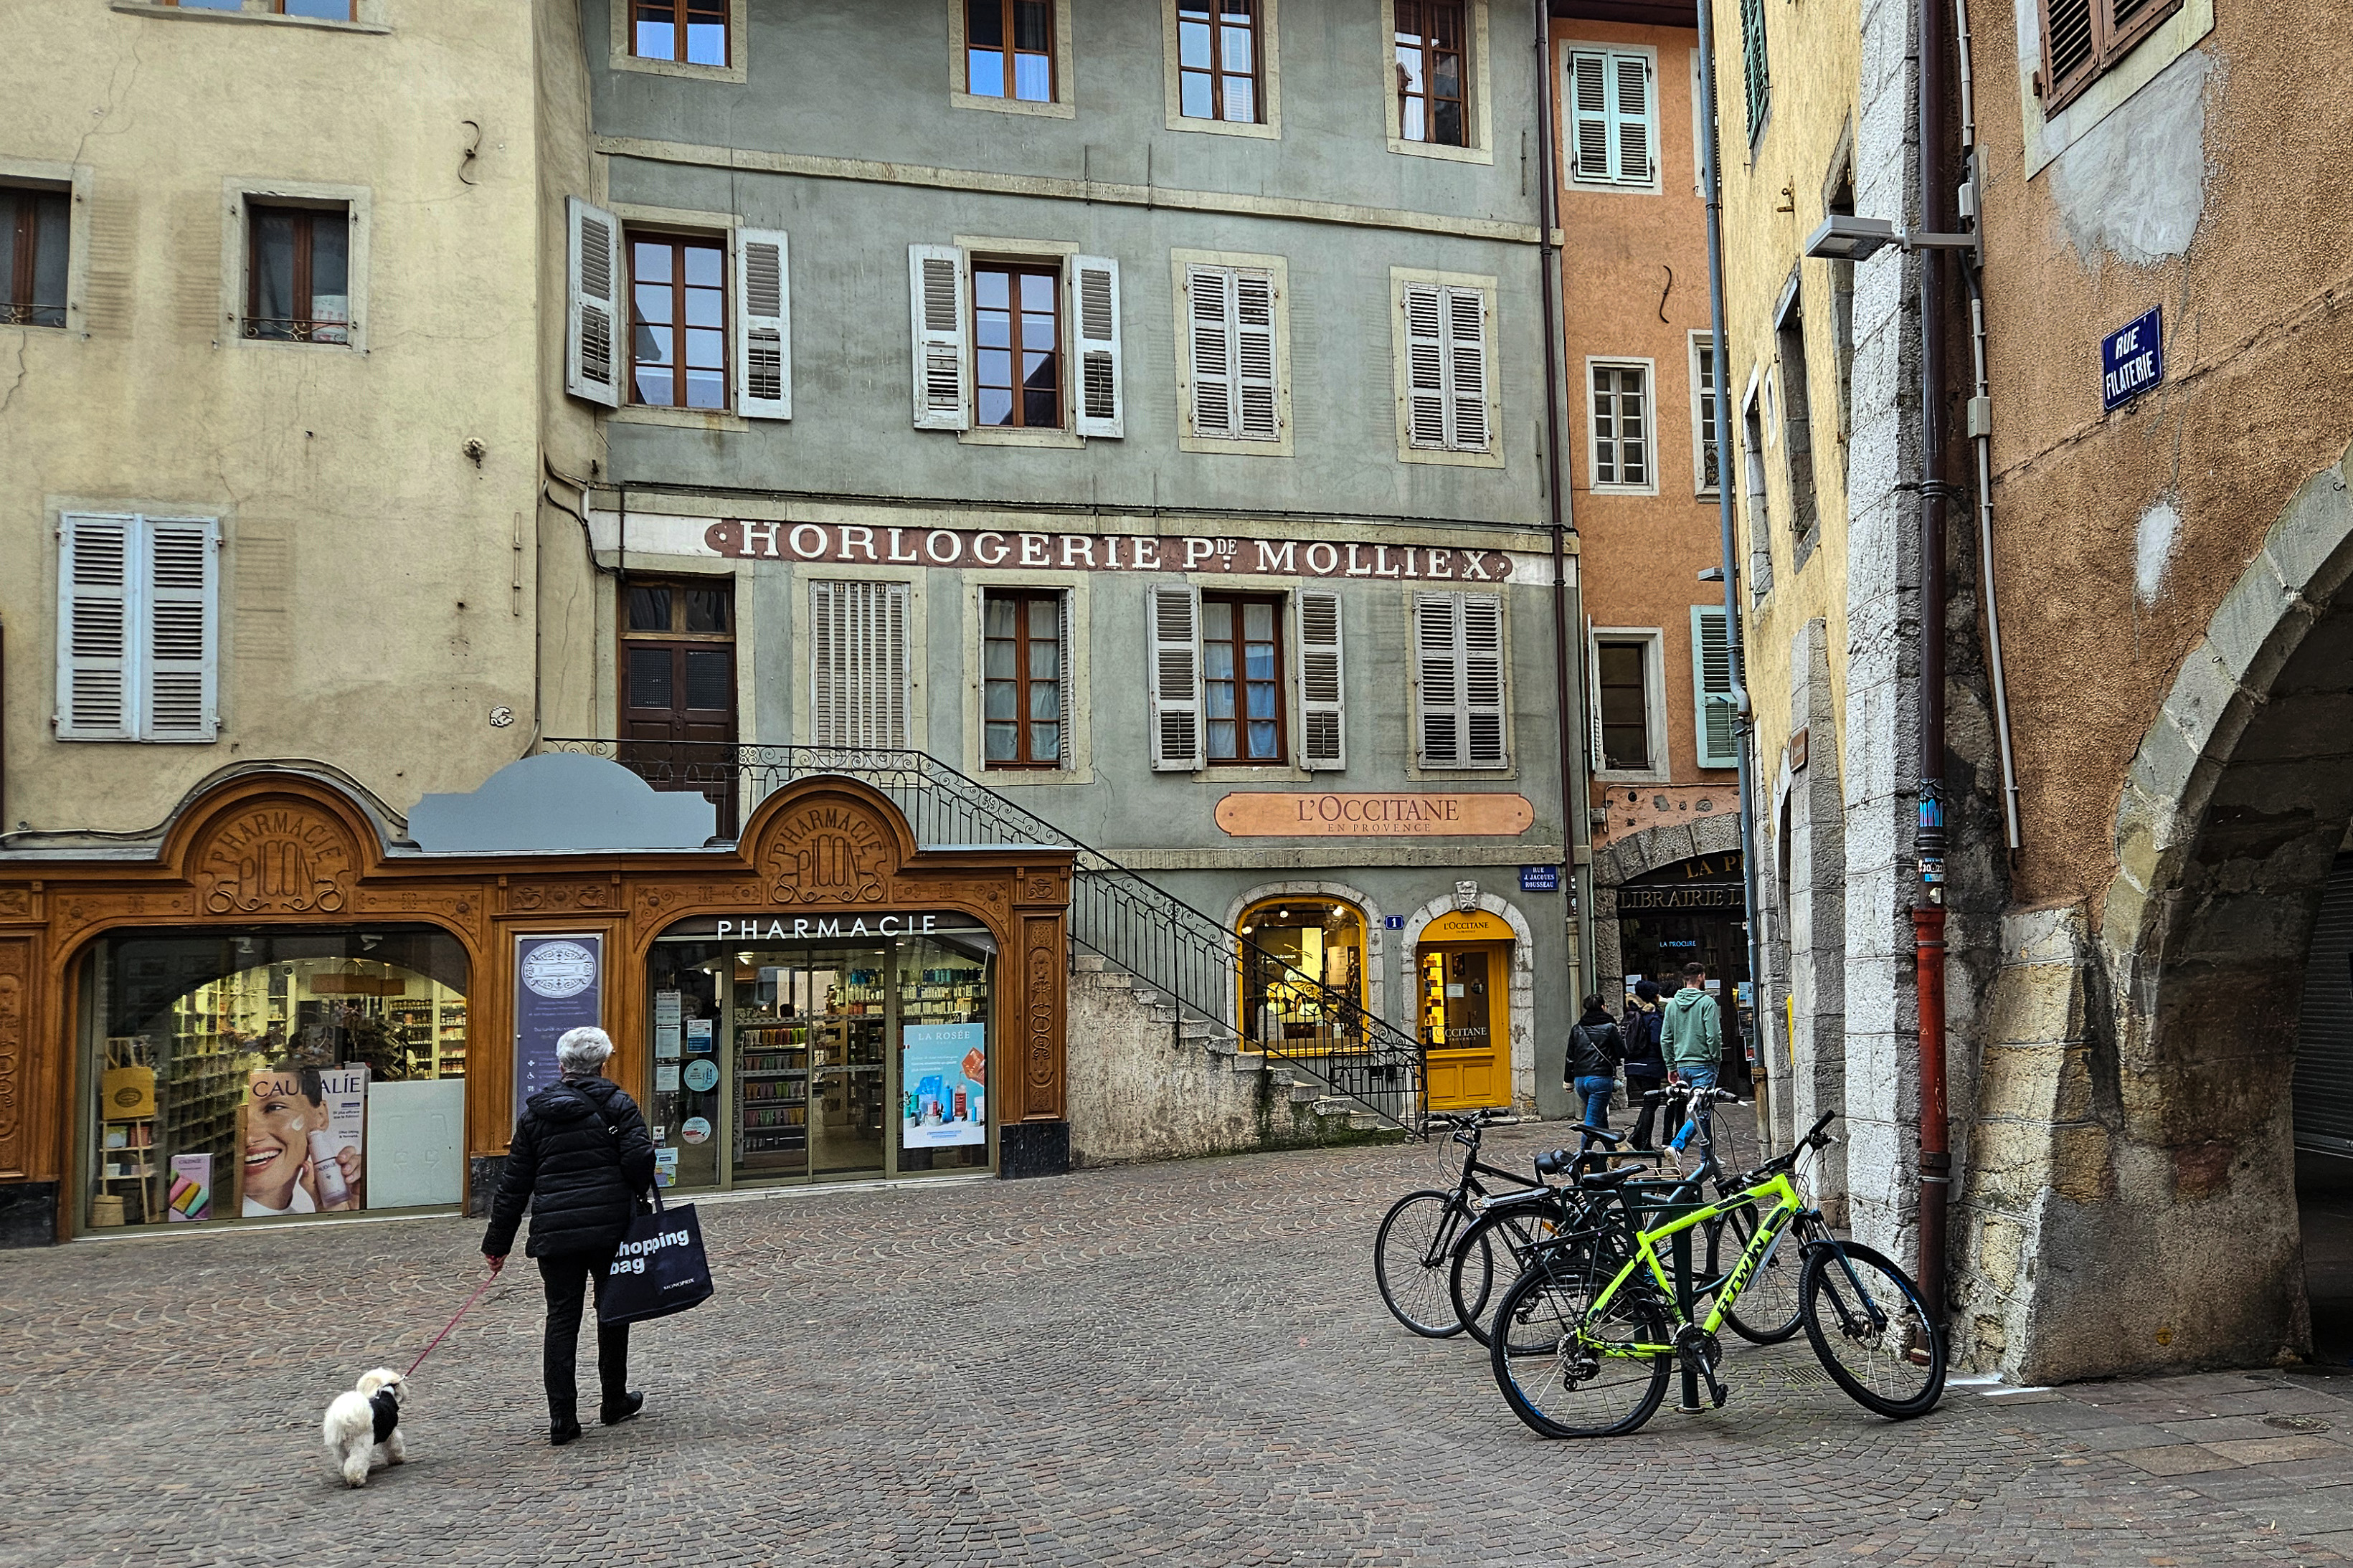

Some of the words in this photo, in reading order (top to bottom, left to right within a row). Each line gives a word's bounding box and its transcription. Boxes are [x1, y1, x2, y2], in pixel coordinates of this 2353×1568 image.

[2115, 326, 2140, 360] RUE
[2106, 350, 2156, 400] FILATERIE
[739, 521, 1160, 569] HORLOGERIE
[1255, 540, 1491, 580] MOLLIEX
[1297, 796, 1459, 822] L'OCCITANE
[211, 812, 341, 865] PHARMACIE
[772, 808, 883, 857] PHARMACIE
[1327, 824, 1345, 832] EN
[1353, 823, 1431, 832] PROVENCE
[236, 839, 317, 898] PICON
[793, 833, 863, 888] PICON
[1685, 860, 1714, 879] LA
[1619, 890, 1723, 909] LIBRAIRIE
[717, 915, 936, 941] PHARMACIE
[1391, 917, 1397, 928] 1
[1444, 921, 1489, 931] L'OCCITANE
[919, 1032, 932, 1041] LA
[935, 1030, 970, 1040] ROSÉE
[615, 1230, 689, 1258] hopping
[610, 1257, 645, 1275] bag
